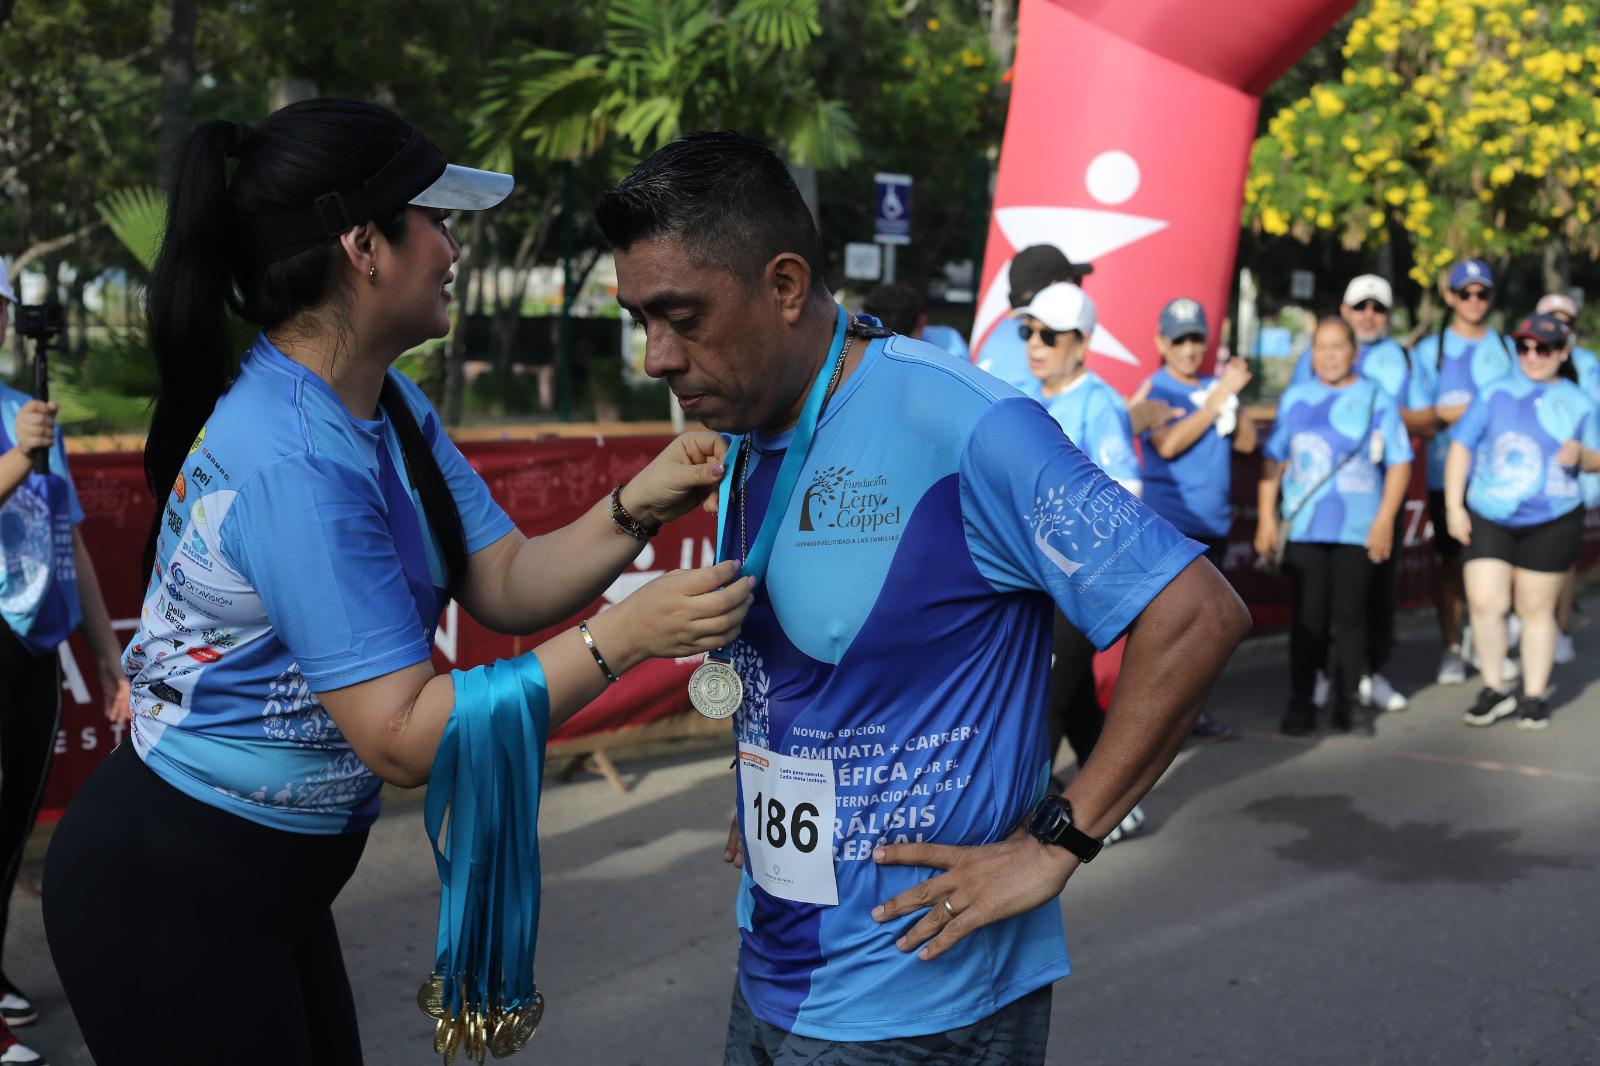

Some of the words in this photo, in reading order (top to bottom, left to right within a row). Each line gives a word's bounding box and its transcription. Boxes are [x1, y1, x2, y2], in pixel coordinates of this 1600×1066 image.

[192, 466, 212, 487] pei
[843, 474, 887, 489] Fundación
[839, 491, 882, 512] Letty
[1075, 487, 1122, 525] Letty
[836, 506, 900, 532] Coppel
[1093, 495, 1145, 539] Coppe
[870, 535, 900, 543] FAMILIAS
[790, 743, 885, 760] CAMINATA
[904, 725, 979, 752] CARRERA
[793, 726, 835, 740] NOVENA
[838, 723, 886, 737] EDICIÓN
[834, 761, 908, 787] ÉFICA
[945, 758, 959, 772] EL
[834, 783, 930, 808] TERNACIONAL
[935, 779, 952, 793] DE
[753, 791, 820, 853] 186
